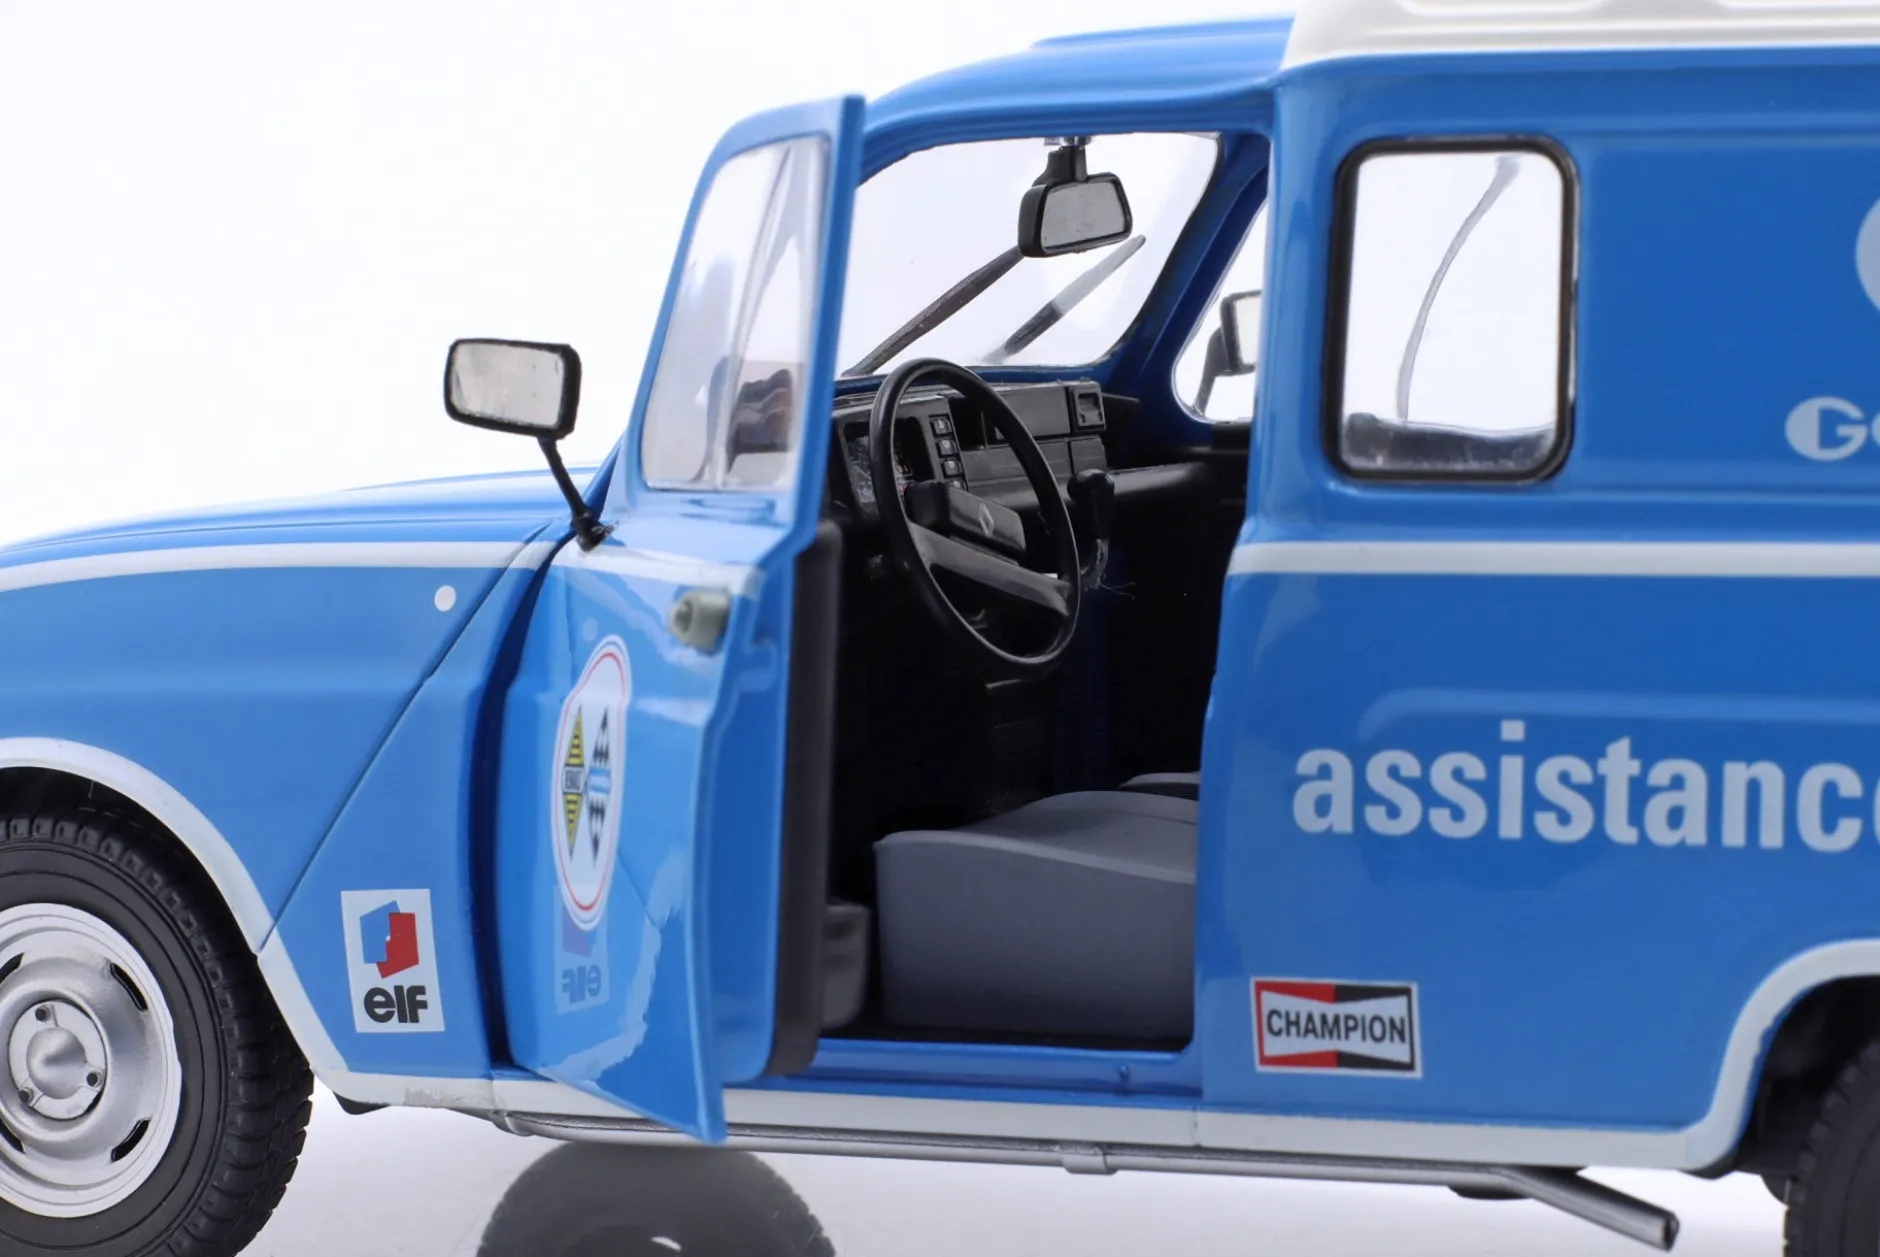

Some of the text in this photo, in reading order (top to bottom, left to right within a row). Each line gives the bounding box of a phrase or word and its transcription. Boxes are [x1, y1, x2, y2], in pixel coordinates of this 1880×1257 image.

[1784, 396, 1880, 461] G
[1293, 719, 1880, 853] assistanc
[363, 985, 428, 1024] elf
[1266, 1009, 1406, 1044] CHAMPION
